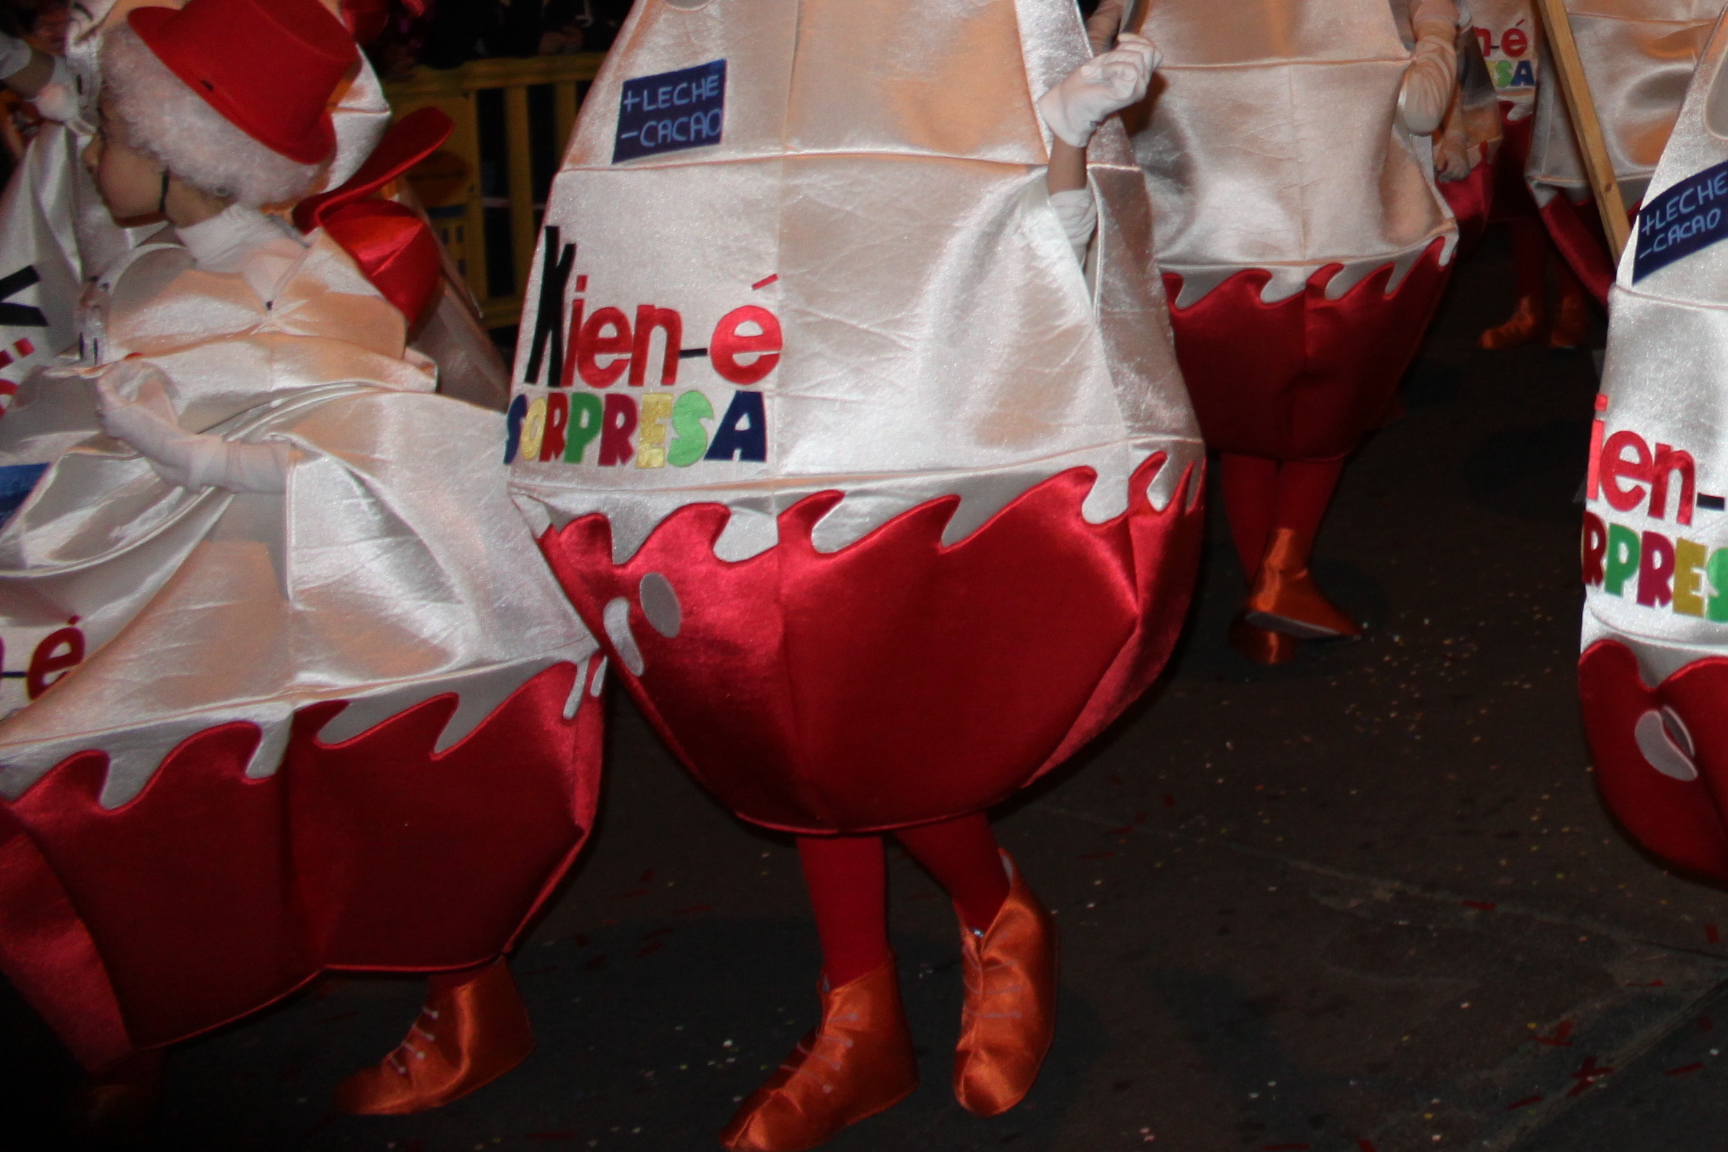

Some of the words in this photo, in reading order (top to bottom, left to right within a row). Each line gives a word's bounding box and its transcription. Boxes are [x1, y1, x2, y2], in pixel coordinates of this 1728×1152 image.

[622, 74, 721, 112] +LECHE
[1640, 169, 1728, 237] +LECHE
[523, 224, 784, 389] Kien-é
[503, 390, 768, 469] SORPRESA
